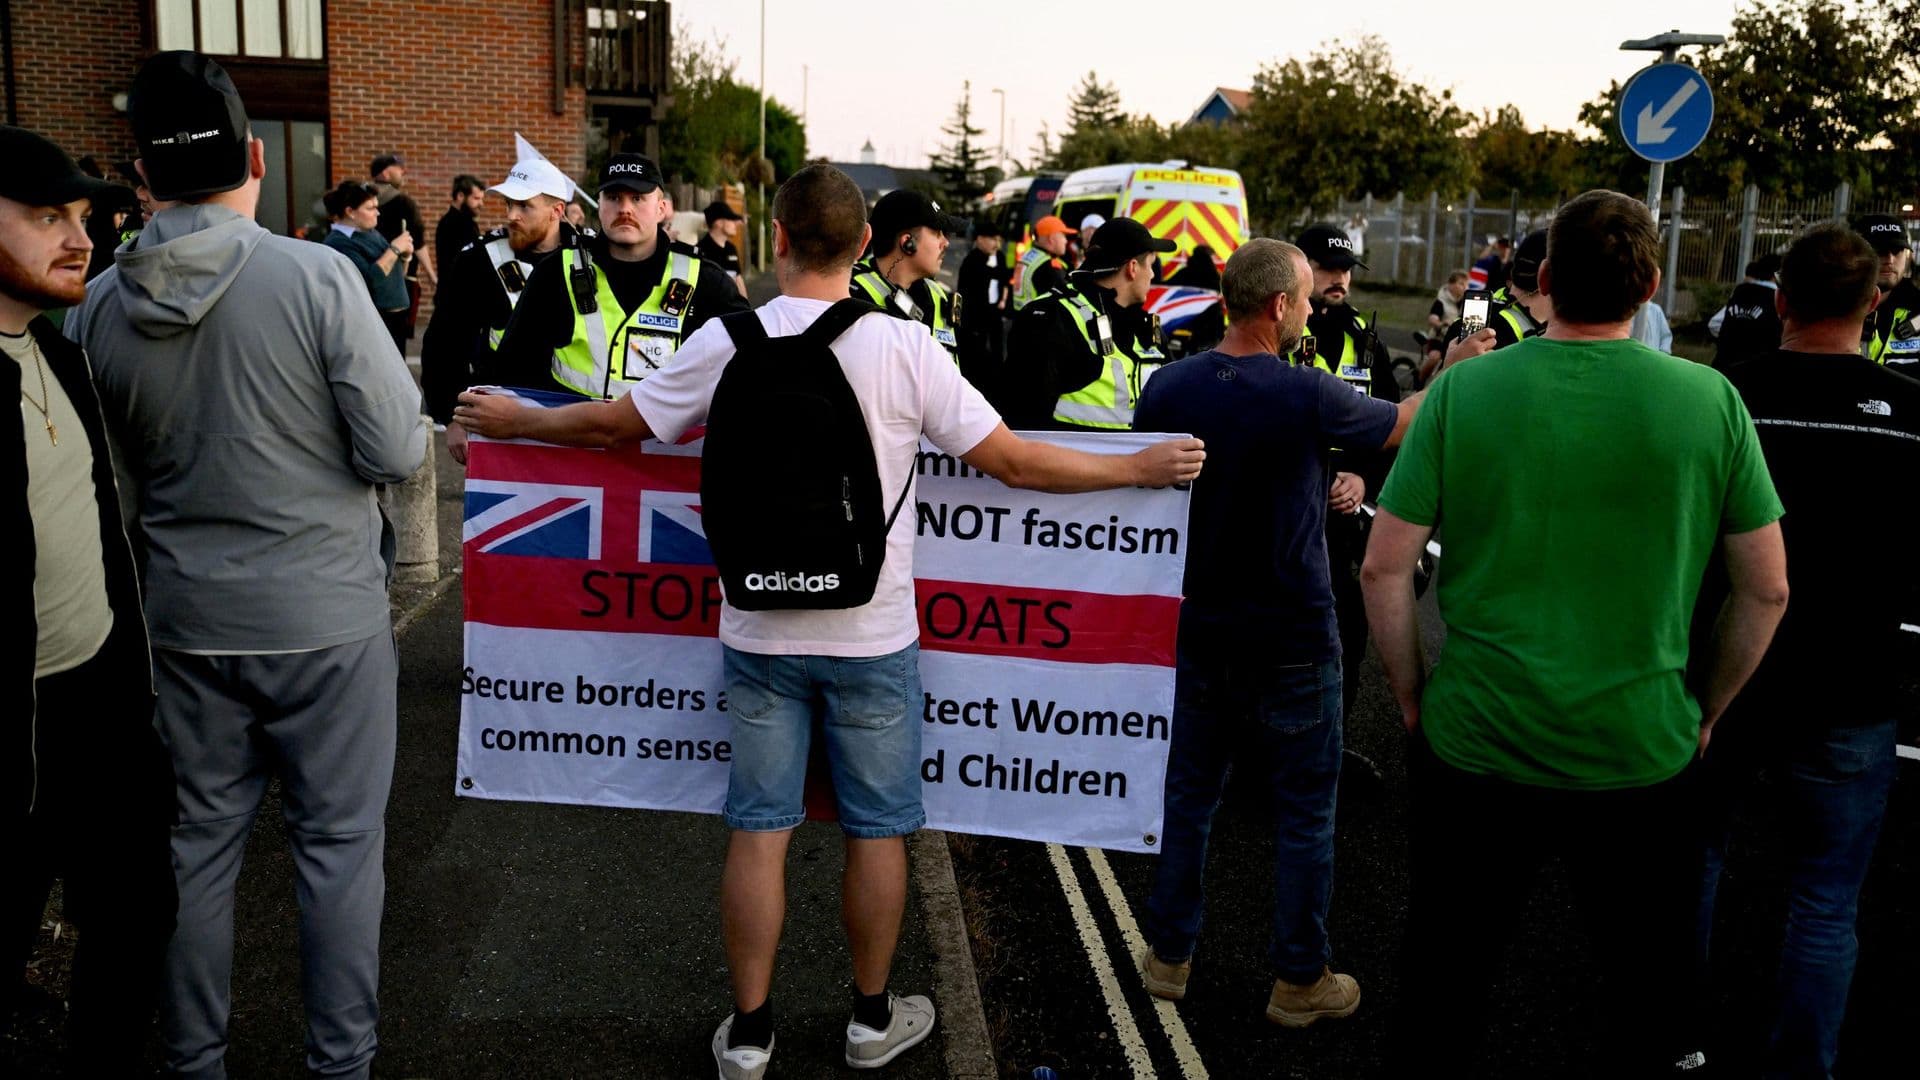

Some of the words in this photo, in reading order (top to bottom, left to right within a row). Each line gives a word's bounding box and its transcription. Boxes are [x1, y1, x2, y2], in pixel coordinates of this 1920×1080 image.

[191, 129, 220, 140] SHOX
[509, 171, 528, 181] LICE
[608, 163, 643, 175] POLICE
[1143, 170, 1230, 186] POLICE
[640, 315, 678, 327] POLICE
[645, 346, 661, 356] HC
[1793, 420, 1807, 428] FACE
[1808, 421, 1819, 429] THE
[1820, 422, 1840, 430] NORTH
[1840, 424, 1856, 432] FACE
[1857, 425, 1868, 433] THE
[1869, 427, 1889, 435] NORTH
[1890, 429, 1905, 438] FACE
[917, 502, 1010, 542] NOT
[1021, 508, 1179, 554] fascism
[745, 570, 840, 593] adidas
[924, 591, 1073, 649] OATS
[461, 667, 564, 703] Secure
[576, 675, 706, 712] borders
[922, 692, 998, 729] tect
[1011, 698, 1168, 741] Women
[481, 728, 626, 757] common
[636, 736, 731, 762] sense
[958, 754, 1127, 798] Children
